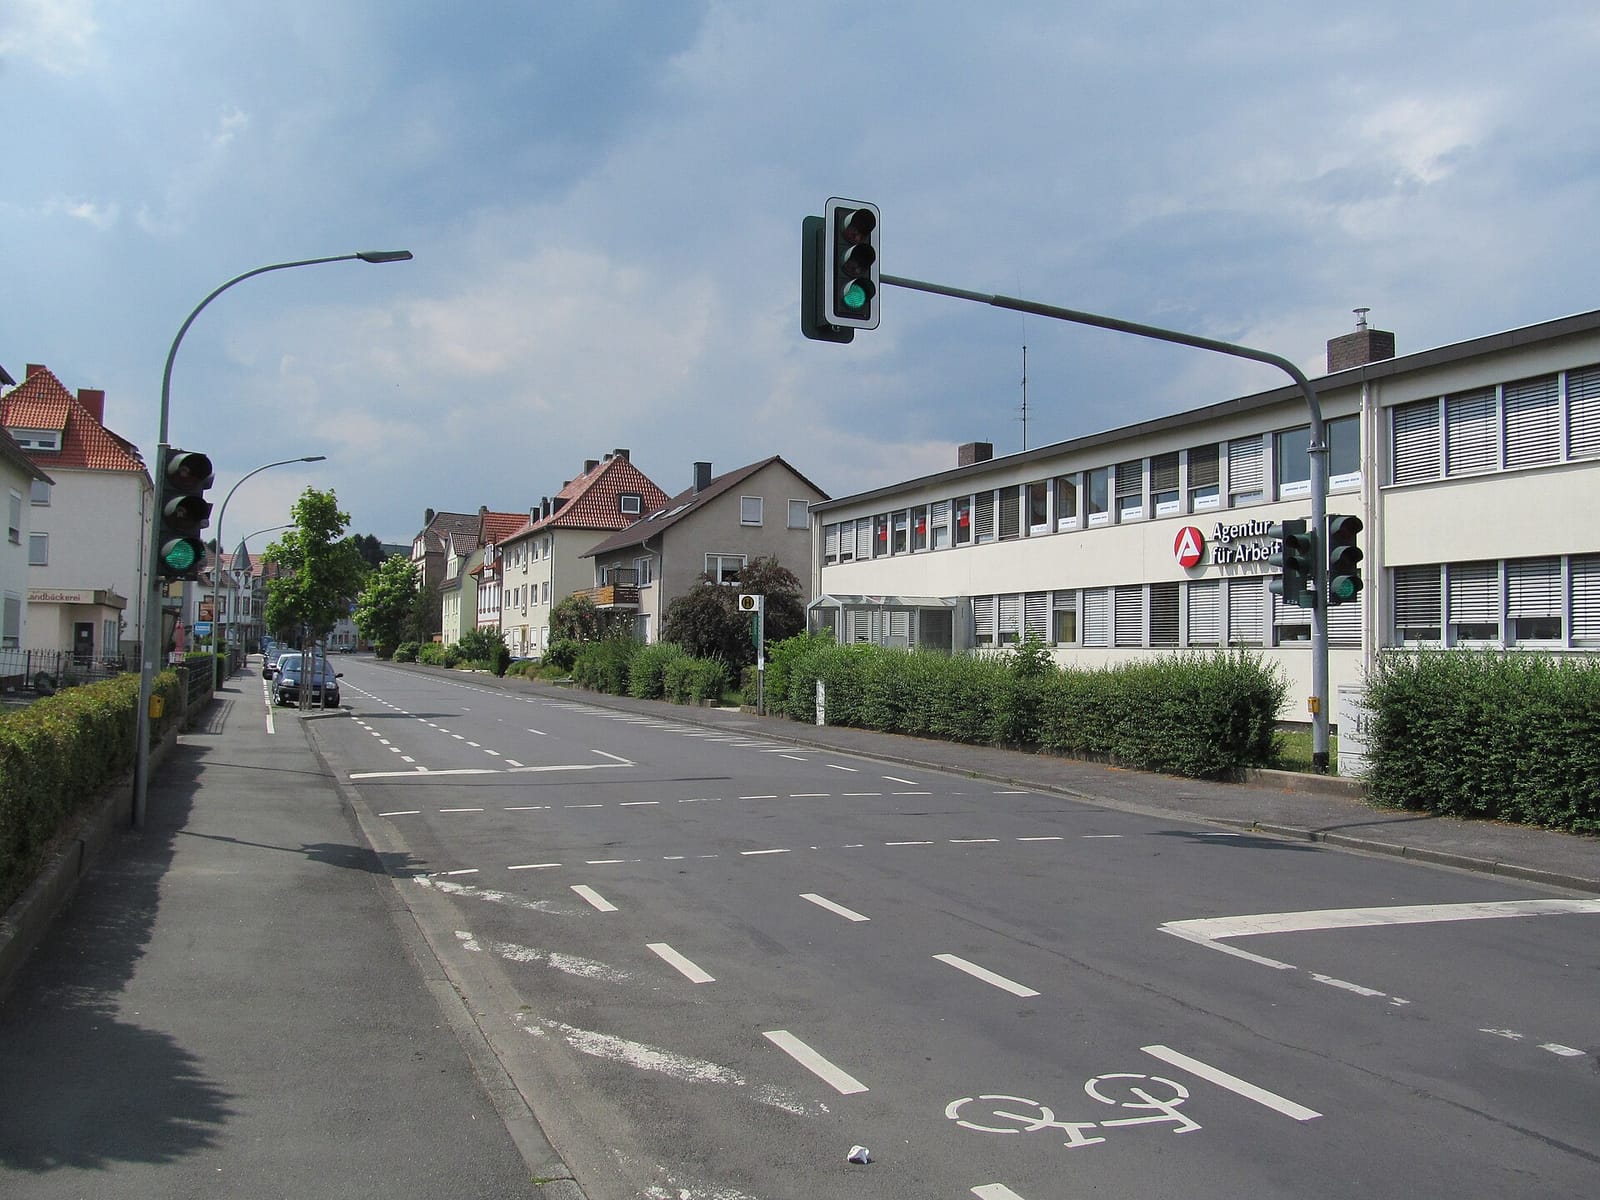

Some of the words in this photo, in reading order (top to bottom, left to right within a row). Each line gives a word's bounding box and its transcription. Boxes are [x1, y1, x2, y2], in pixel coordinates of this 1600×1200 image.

[1213, 518, 1272, 543] Agentur
[1213, 546, 1233, 565] für
[1235, 541, 1281, 563] Arbeit
